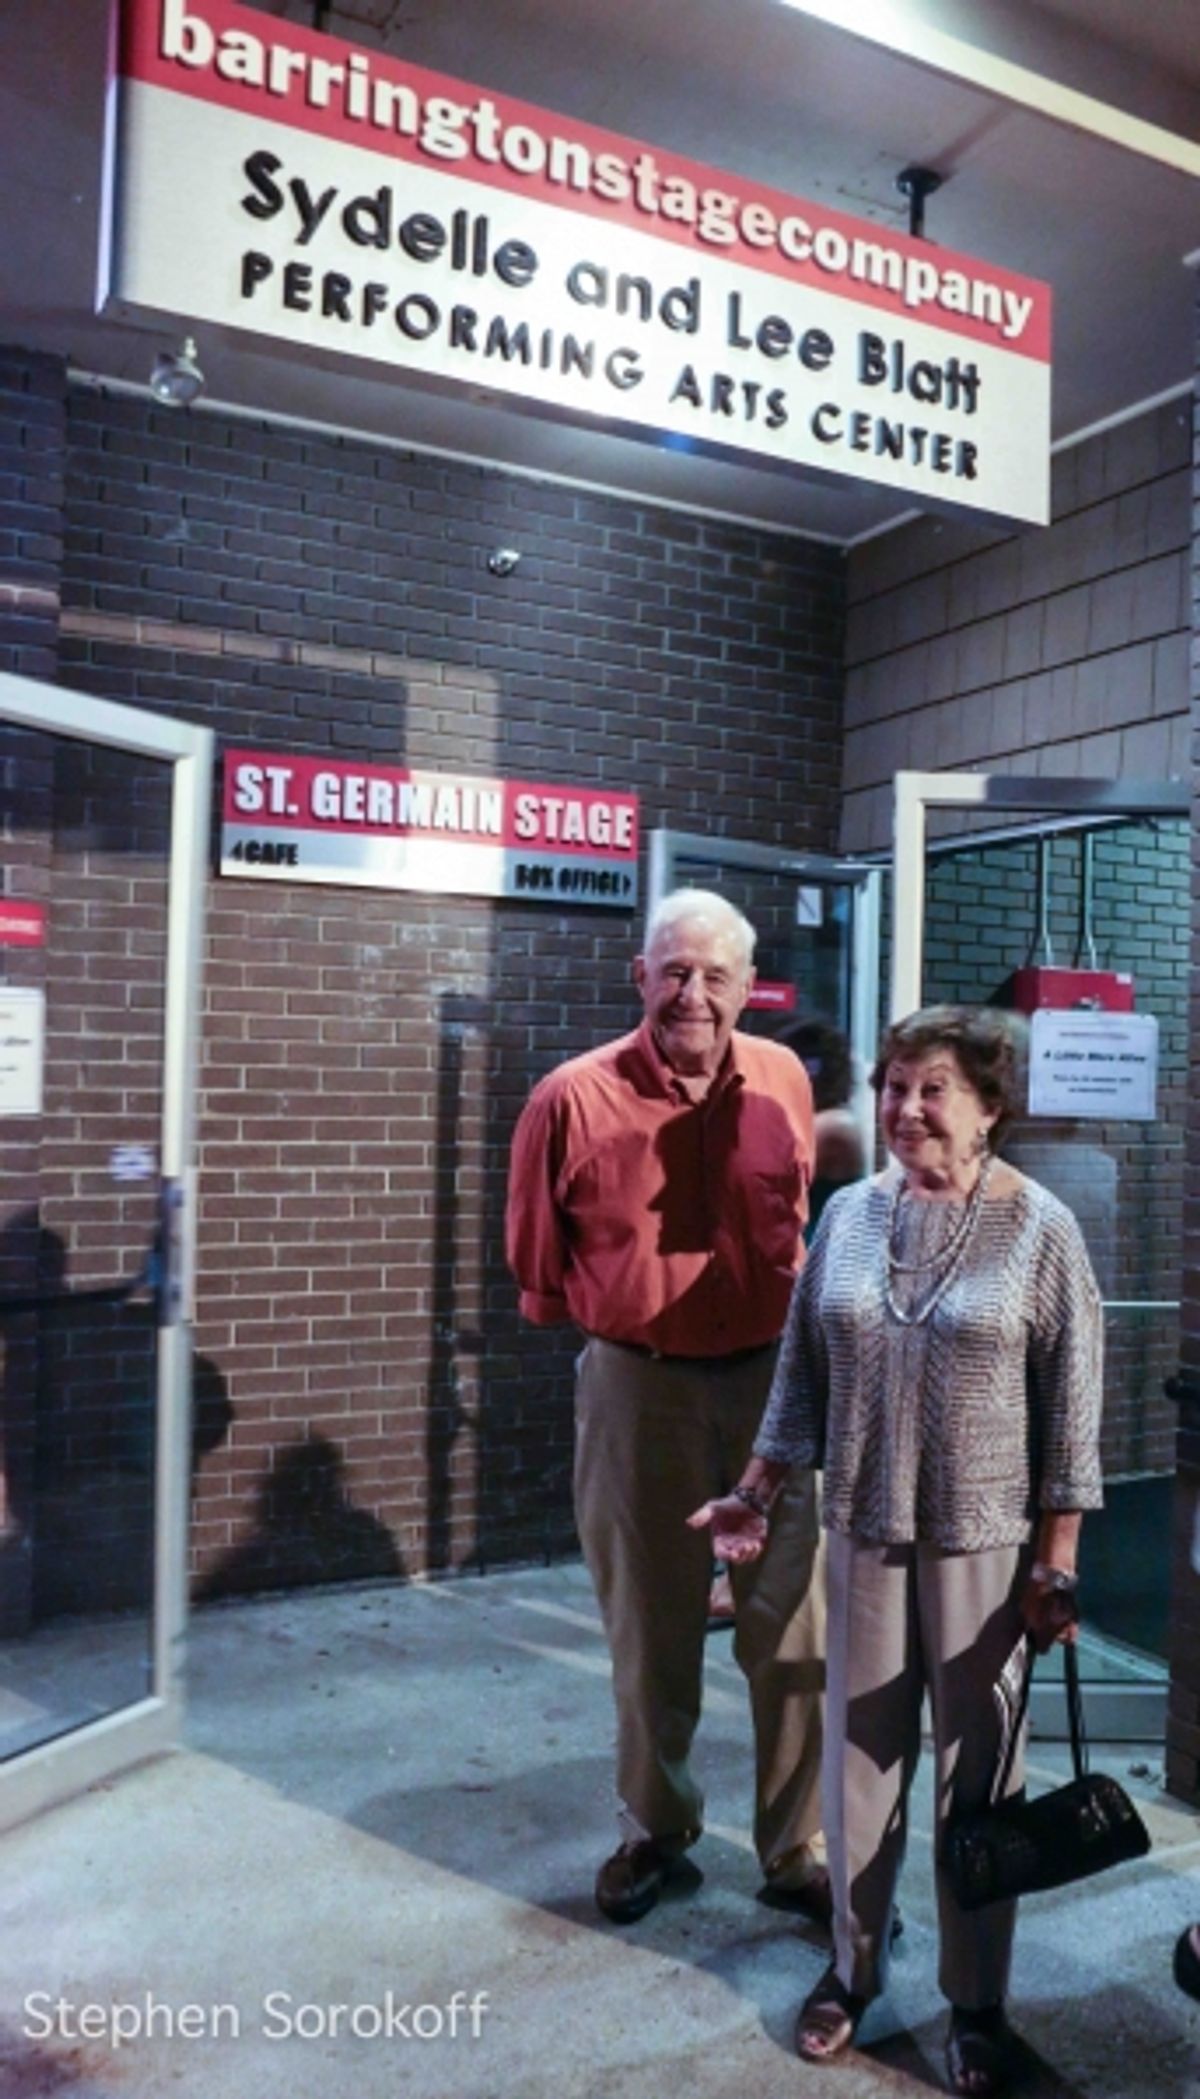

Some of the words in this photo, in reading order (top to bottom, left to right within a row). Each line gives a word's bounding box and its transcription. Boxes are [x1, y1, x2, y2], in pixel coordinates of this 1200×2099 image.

[159, 0, 1033, 338] barringtonstagecompany
[241, 150, 539, 288] Sydelle
[566, 261, 700, 334] and
[727, 291, 834, 371] Lee
[857, 331, 981, 415] Blatt
[241, 251, 645, 390] PERFORMING
[669, 364, 789, 429] ARTS
[811, 403, 978, 480] CENTER
[234, 764, 298, 816] ST.
[311, 772, 501, 836] GERMAIN
[514, 794, 633, 849] STAGE
[245, 840, 299, 866] CAFE
[515, 864, 554, 889] BOX
[558, 867, 622, 896] OFFICE
